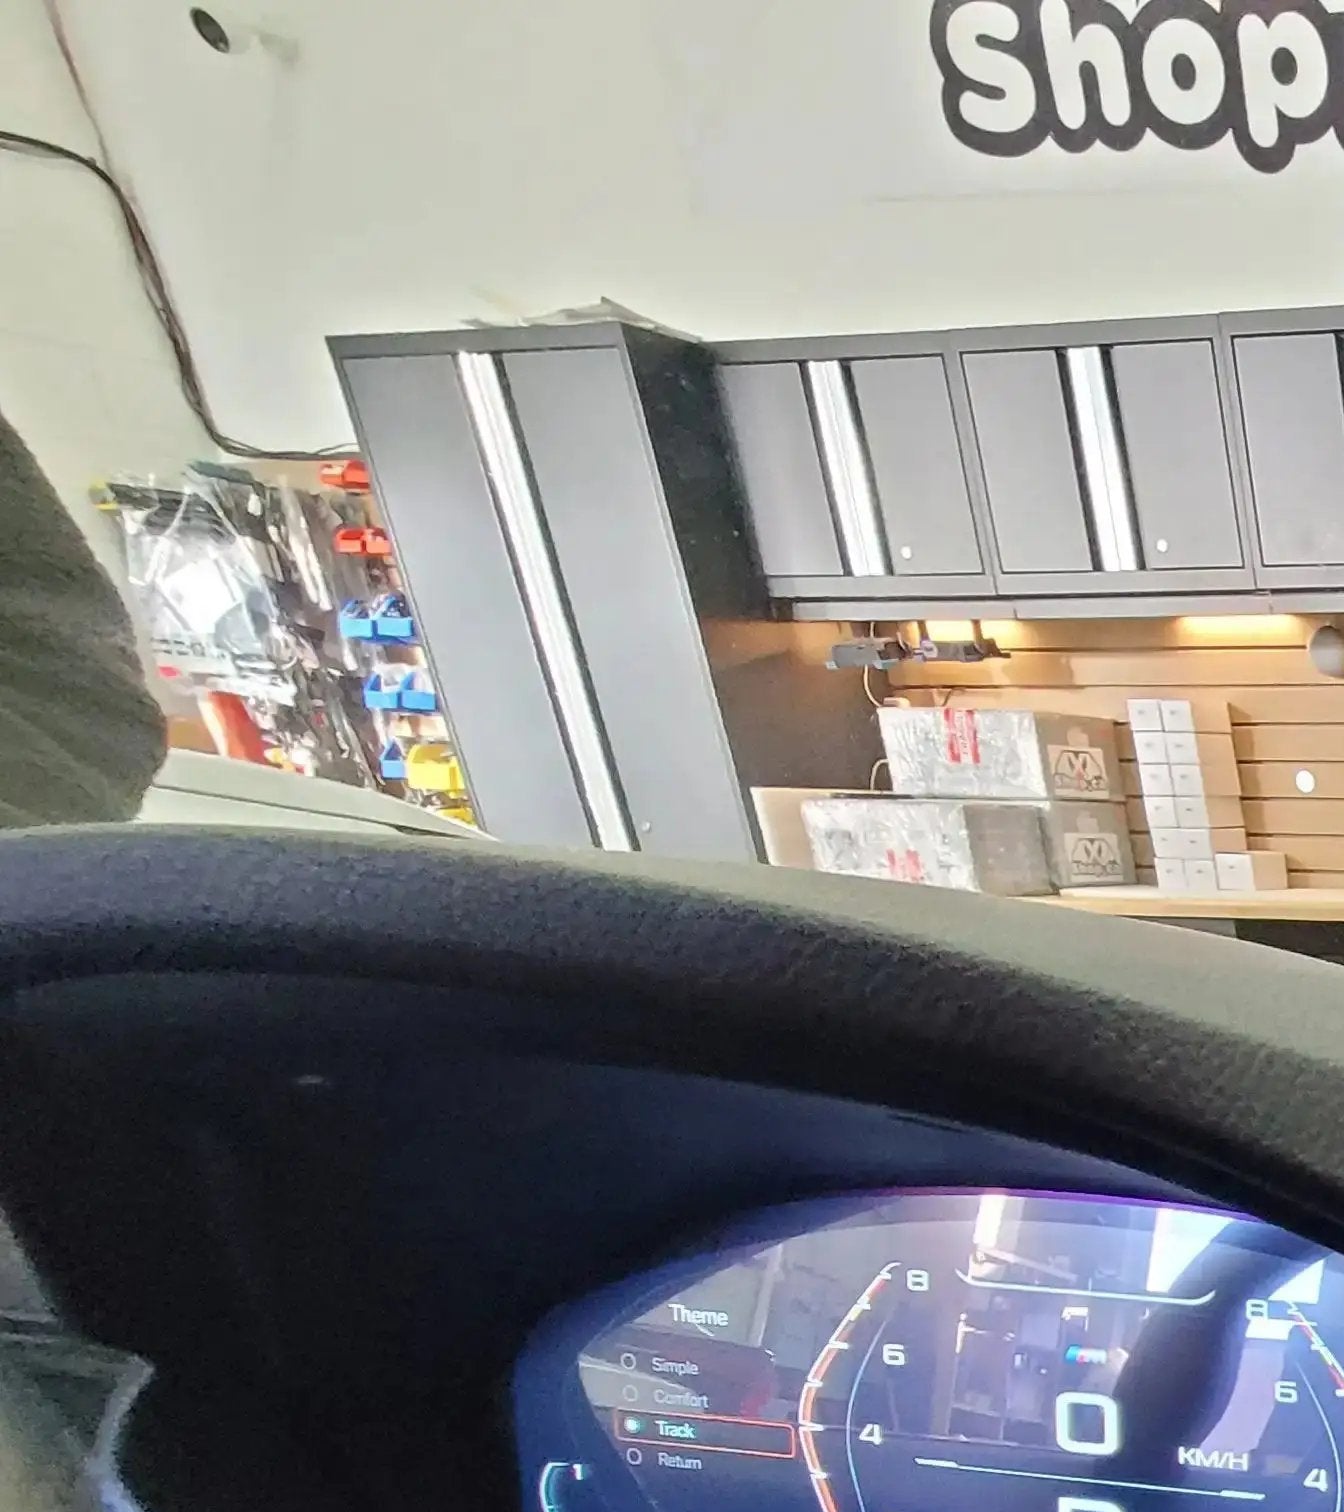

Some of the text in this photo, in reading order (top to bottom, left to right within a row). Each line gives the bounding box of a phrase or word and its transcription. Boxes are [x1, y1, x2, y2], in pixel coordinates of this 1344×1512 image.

[905, 1267, 930, 1292] 8
[667, 1302, 730, 1327] Theme
[651, 1356, 700, 1376] Simple
[881, 1343, 907, 1366] 6
[653, 1388, 710, 1409] Comfort
[1274, 1381, 1298, 1402] 6
[654, 1420, 697, 1439] Track
[859, 1423, 884, 1446] 4
[657, 1451, 703, 1471] Return
[1176, 1444, 1250, 1473] KM/H
[1303, 1468, 1328, 1492] 4
